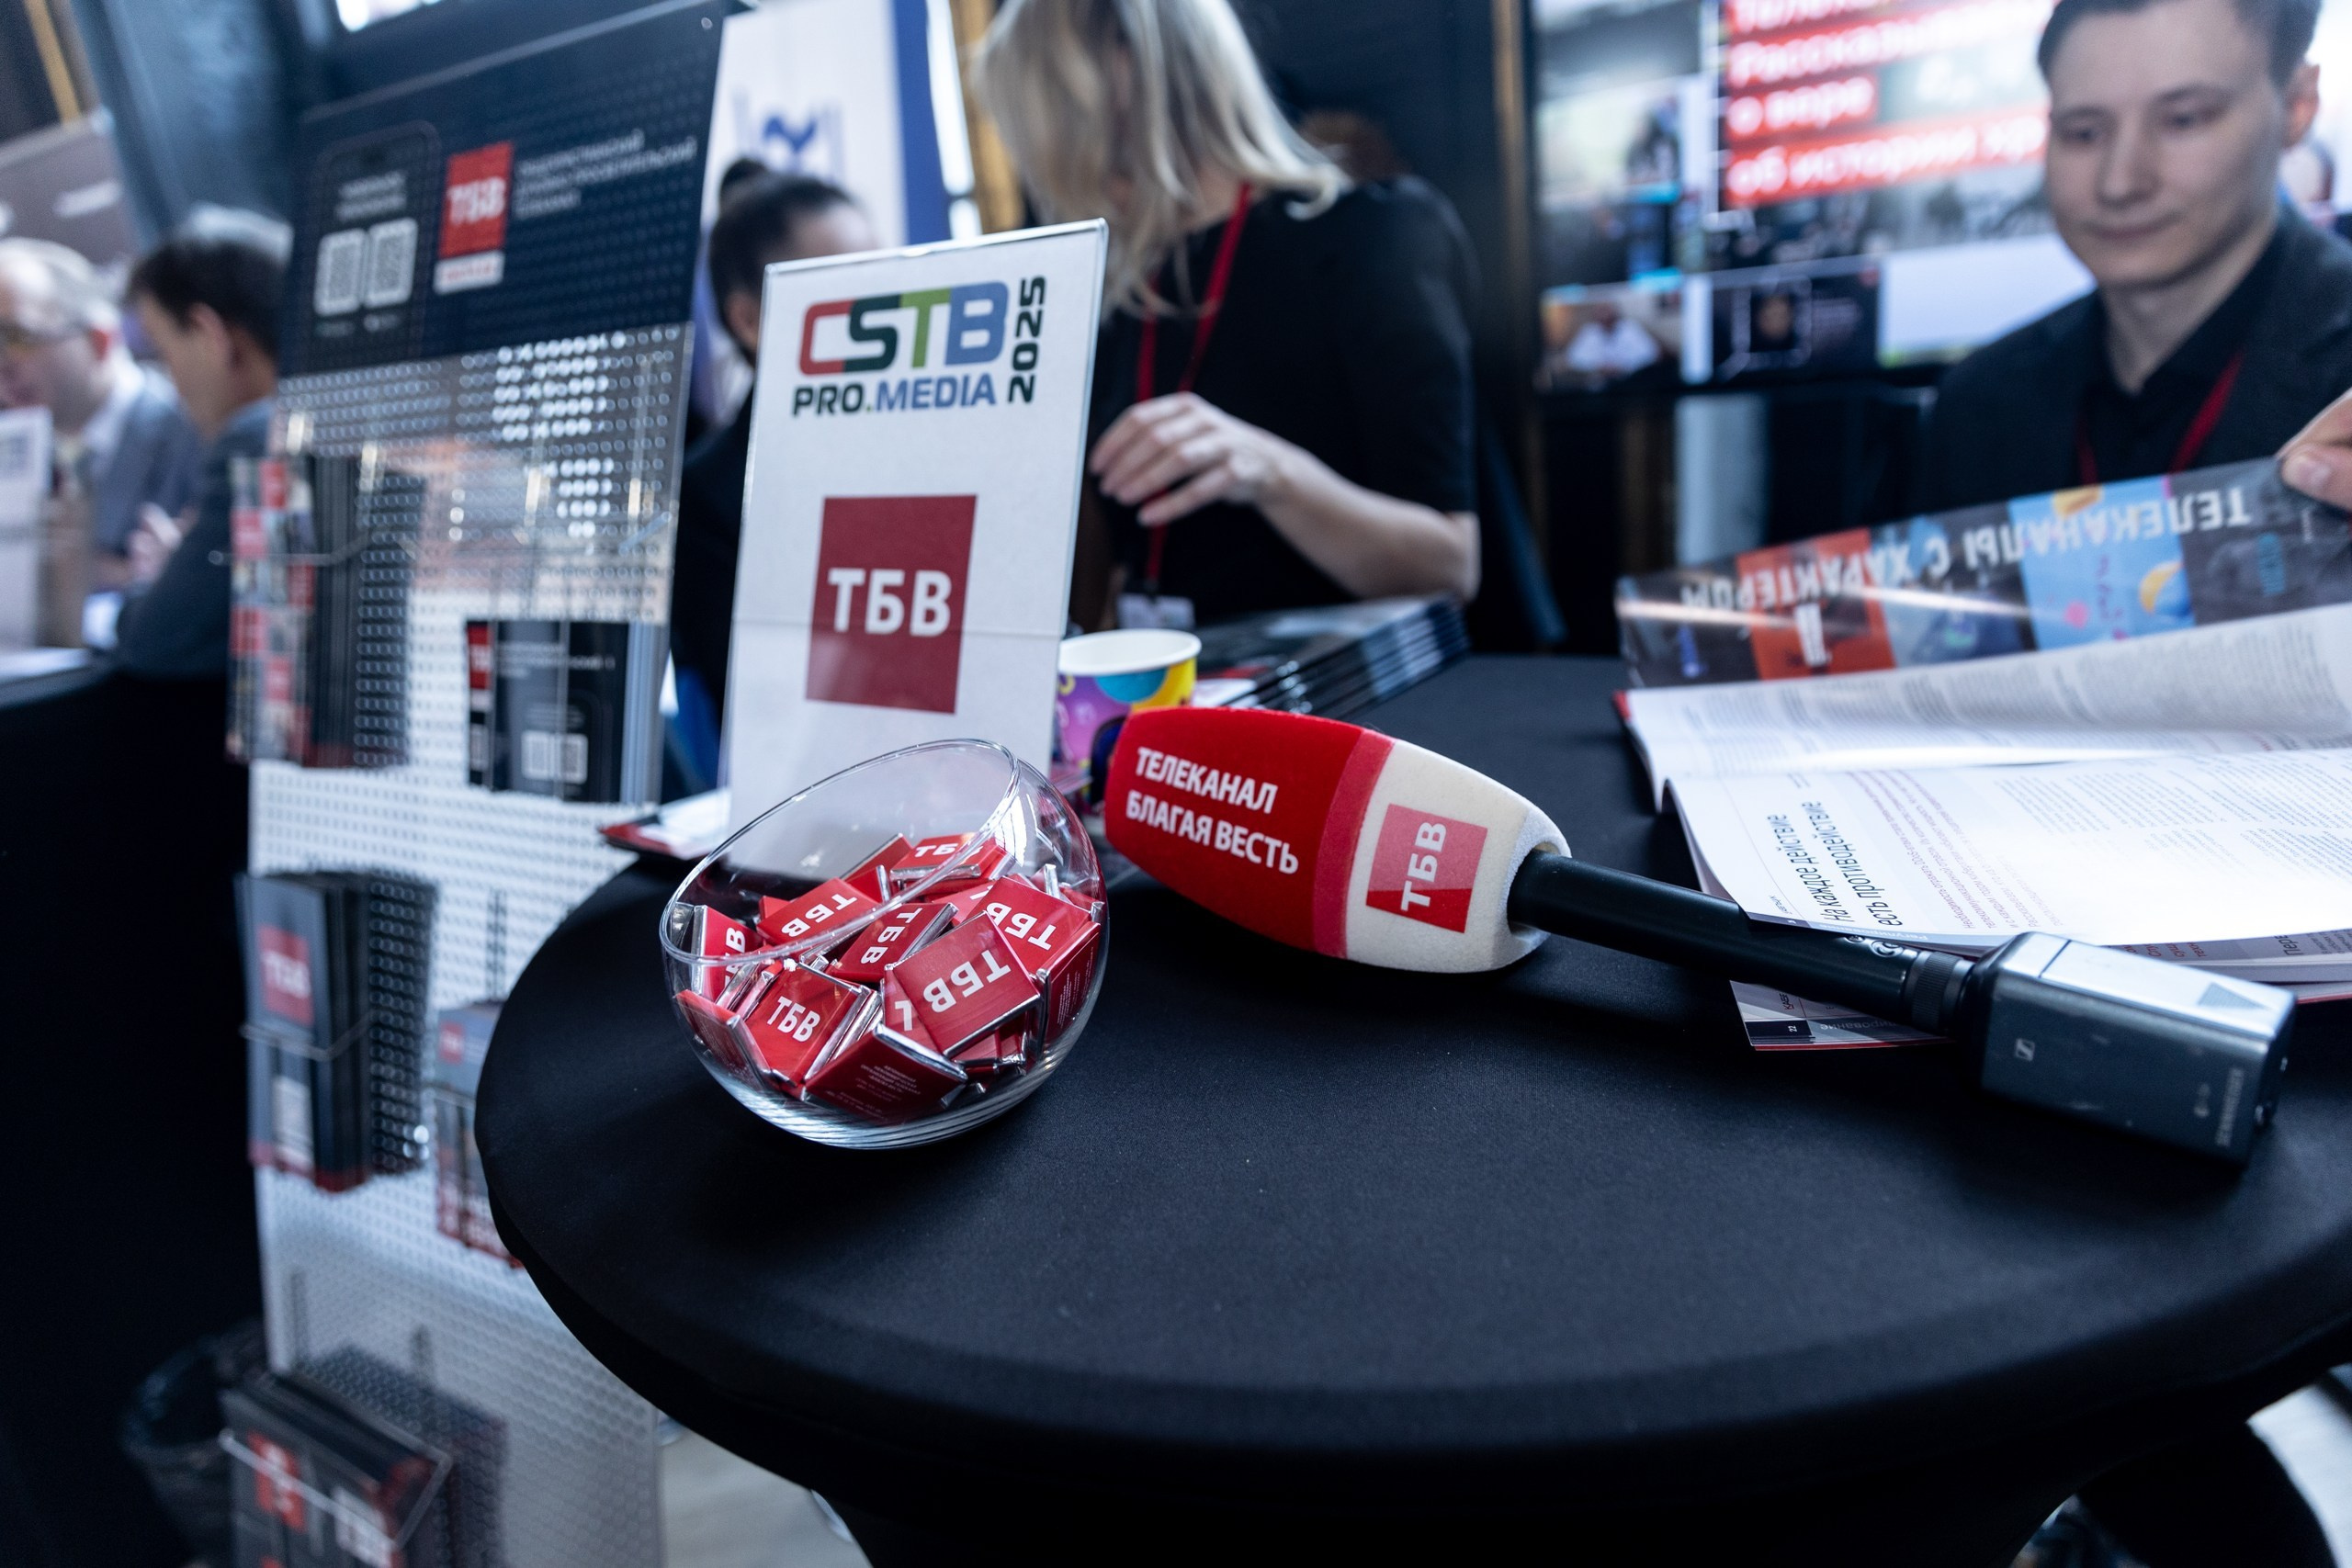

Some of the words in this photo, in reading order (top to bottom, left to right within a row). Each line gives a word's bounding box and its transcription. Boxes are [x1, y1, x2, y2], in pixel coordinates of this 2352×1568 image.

[799, 281, 1009, 377] CSTB
[1008, 276, 1047, 404] 2025
[792, 373, 998, 417] PRO.MEDIA
[1962, 486, 2251, 570] ТЕЛЕКАНАЛЫ
[828, 568, 953, 637] ТБВ
[1136, 746, 1279, 814] ТЕЛЕКАНАЛ
[1125, 789, 1213, 846] БЛАГАЯ
[1214, 819, 1299, 874] ВЕСТЬ
[1767, 814, 1819, 864] действие
[1801, 801, 1885, 898] противодействие
[1400, 822, 1447, 912] ТБВ
[1795, 867, 1843, 909] каждое
[781, 894, 857, 937] ТБВ
[860, 908, 922, 964] ТБВ
[986, 902, 1057, 950] ТБВ
[1820, 908, 1855, 922] На
[1865, 900, 1903, 926] есть
[922, 950, 1012, 1013] ТБВ
[767, 996, 820, 1042] ТБВ
